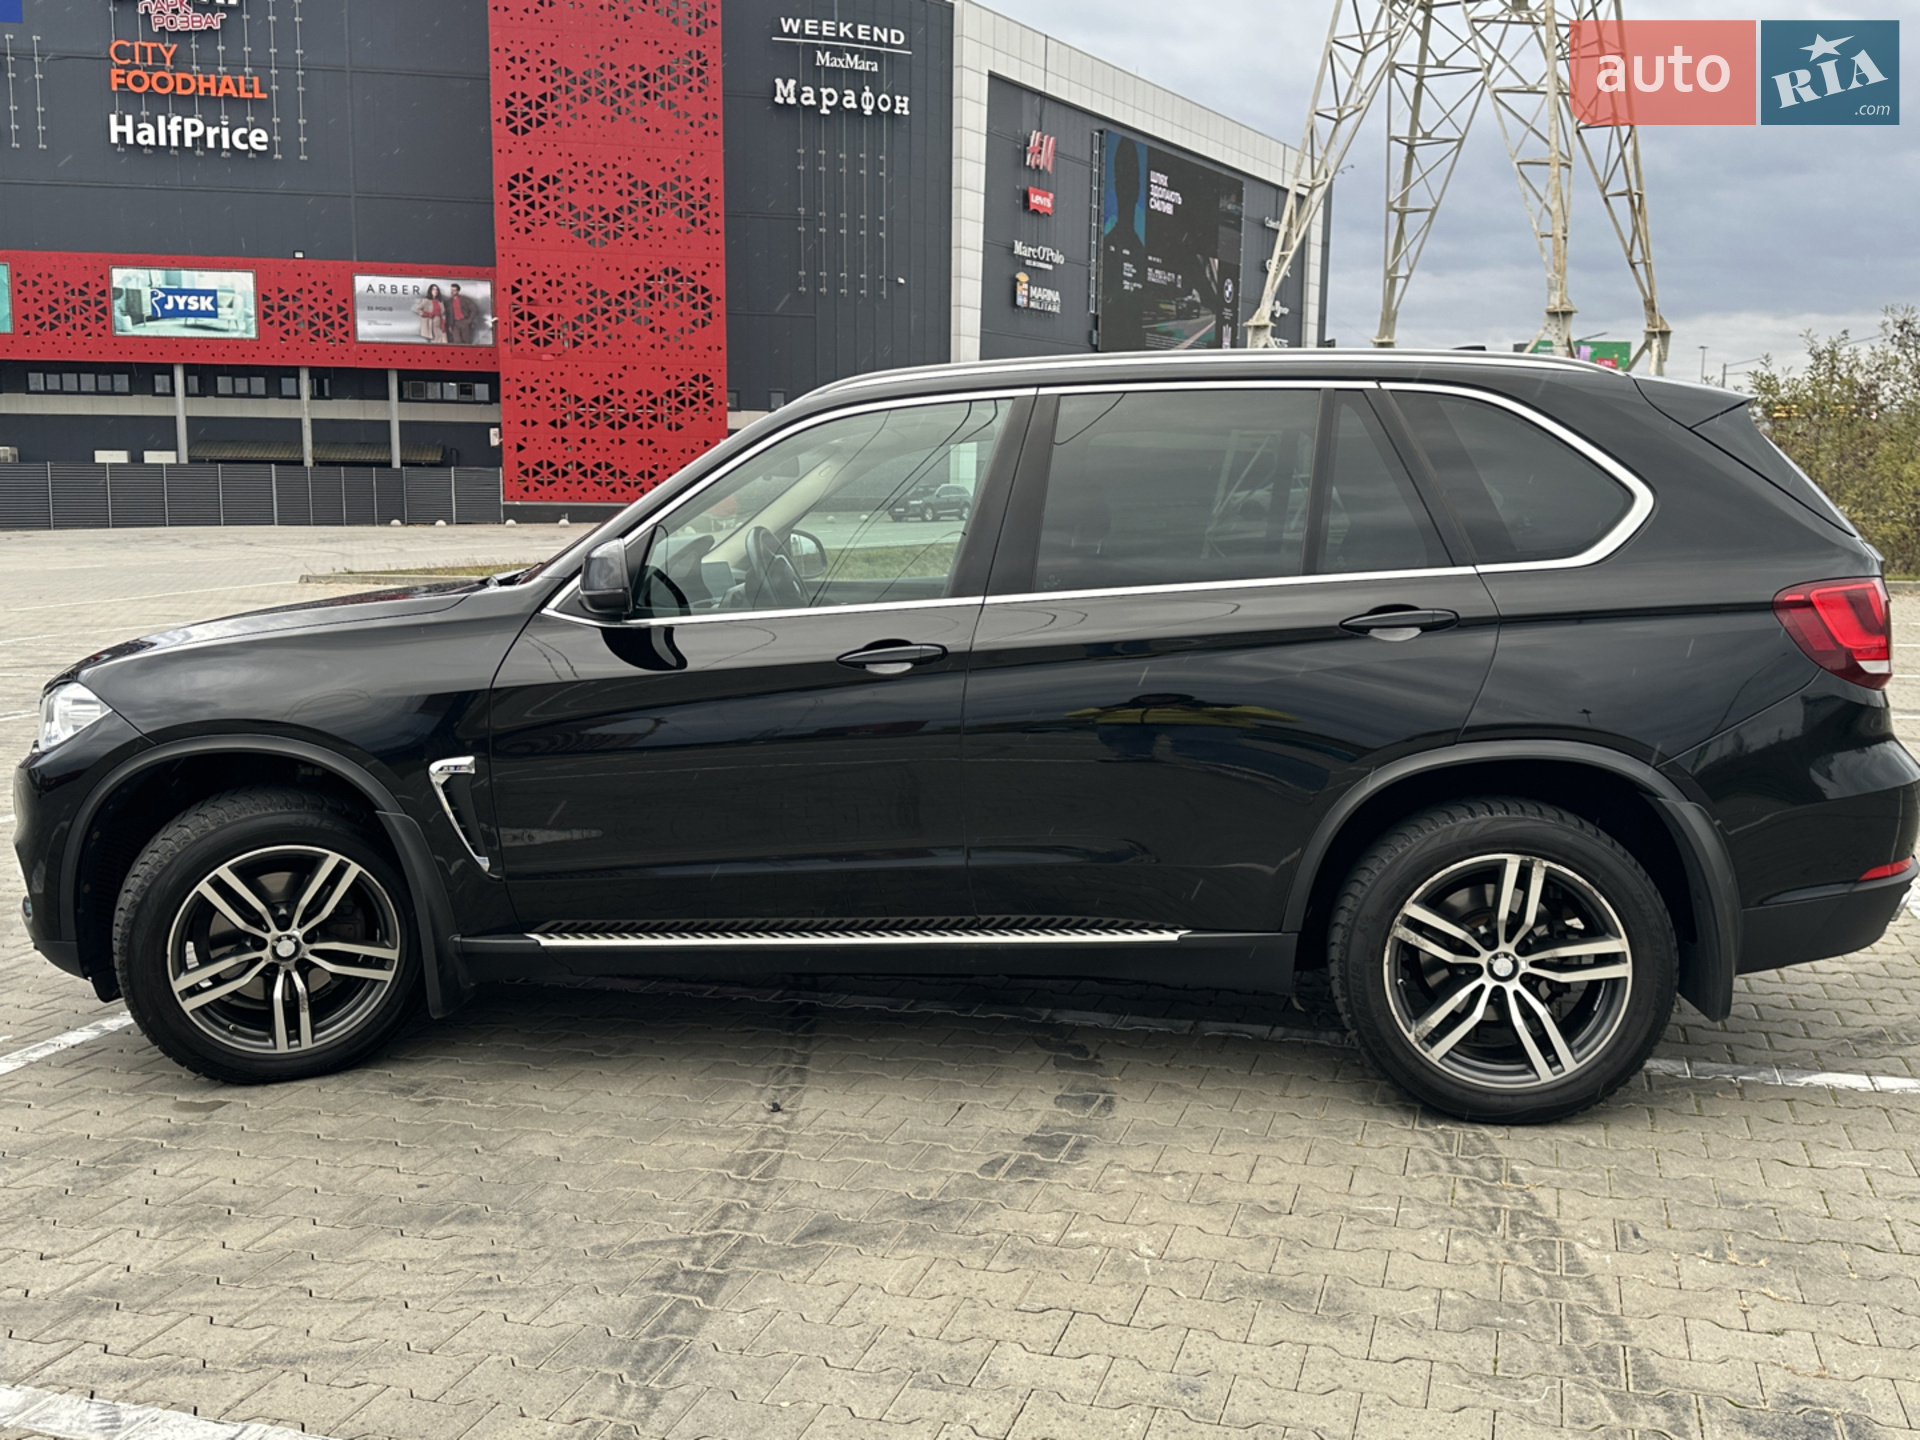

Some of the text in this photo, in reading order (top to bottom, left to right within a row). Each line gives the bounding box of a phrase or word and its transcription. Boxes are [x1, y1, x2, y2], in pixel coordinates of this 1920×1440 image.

[139, 0, 193, 14] ПАРК
[151, 12, 227, 32] РОЗВАГ
[780, 17, 905, 45] WEEKEND
[109, 40, 178, 67] CITY
[815, 51, 879, 72] MaxMara
[110, 68, 268, 99] FOODHALL
[774, 78, 910, 116] Марафон
[109, 114, 268, 150] HalfPrice
[1026, 129, 1056, 175] H&M
[366, 283, 421, 296] ARBER
[1029, 285, 1061, 303] MARINA
[164, 295, 216, 312] JYSK
